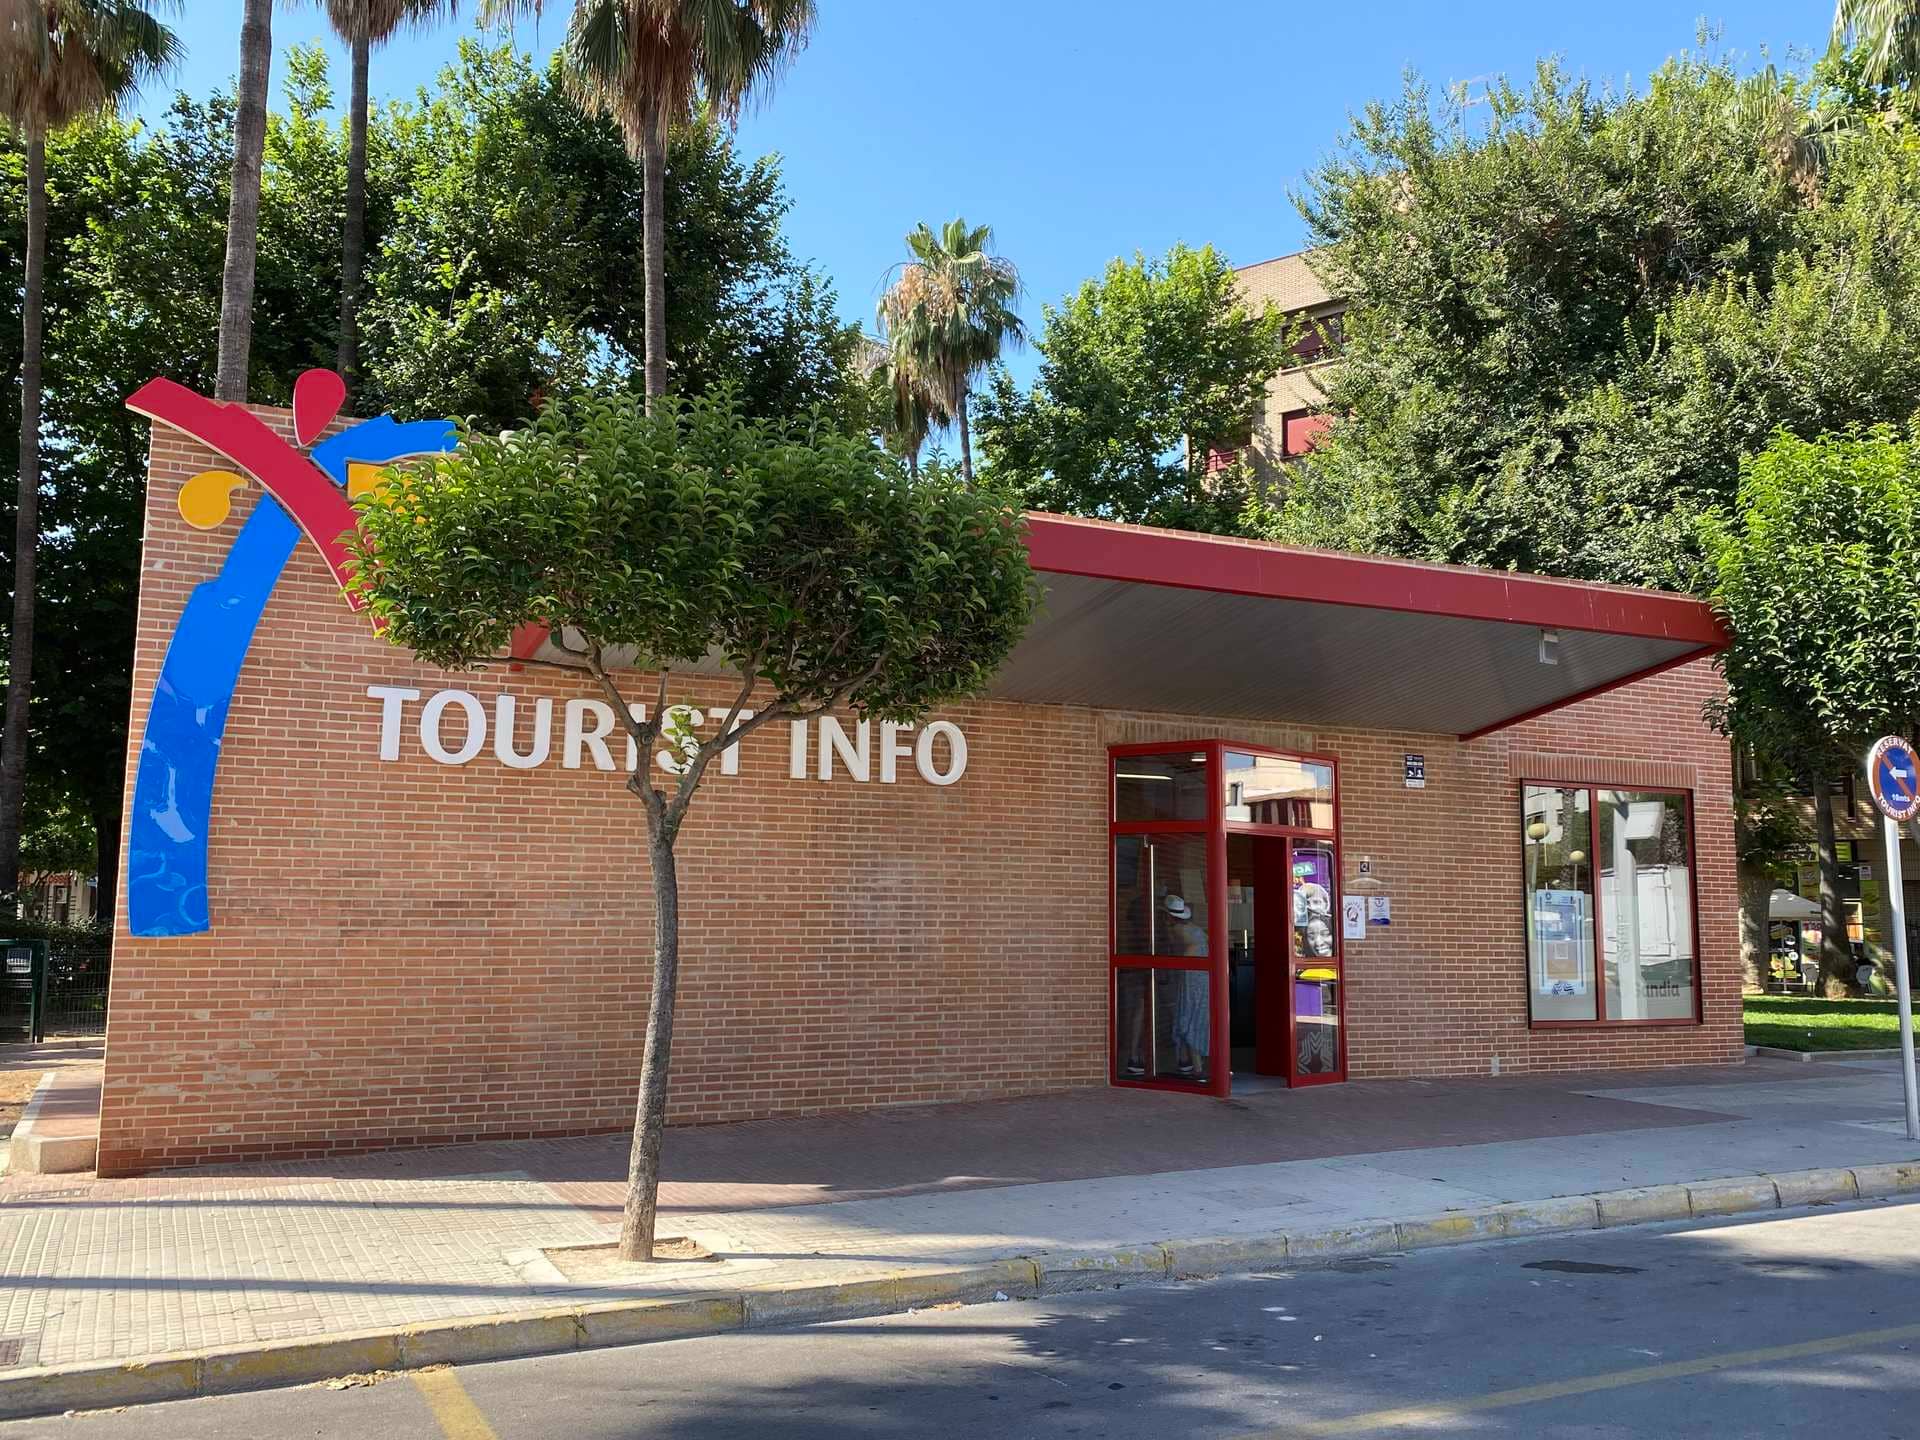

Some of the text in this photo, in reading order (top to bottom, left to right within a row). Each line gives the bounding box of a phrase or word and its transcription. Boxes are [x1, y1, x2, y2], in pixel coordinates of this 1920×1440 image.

[367, 686, 968, 785] TOURIST INFO
[1879, 793, 1920, 818] TOURIST INFO
